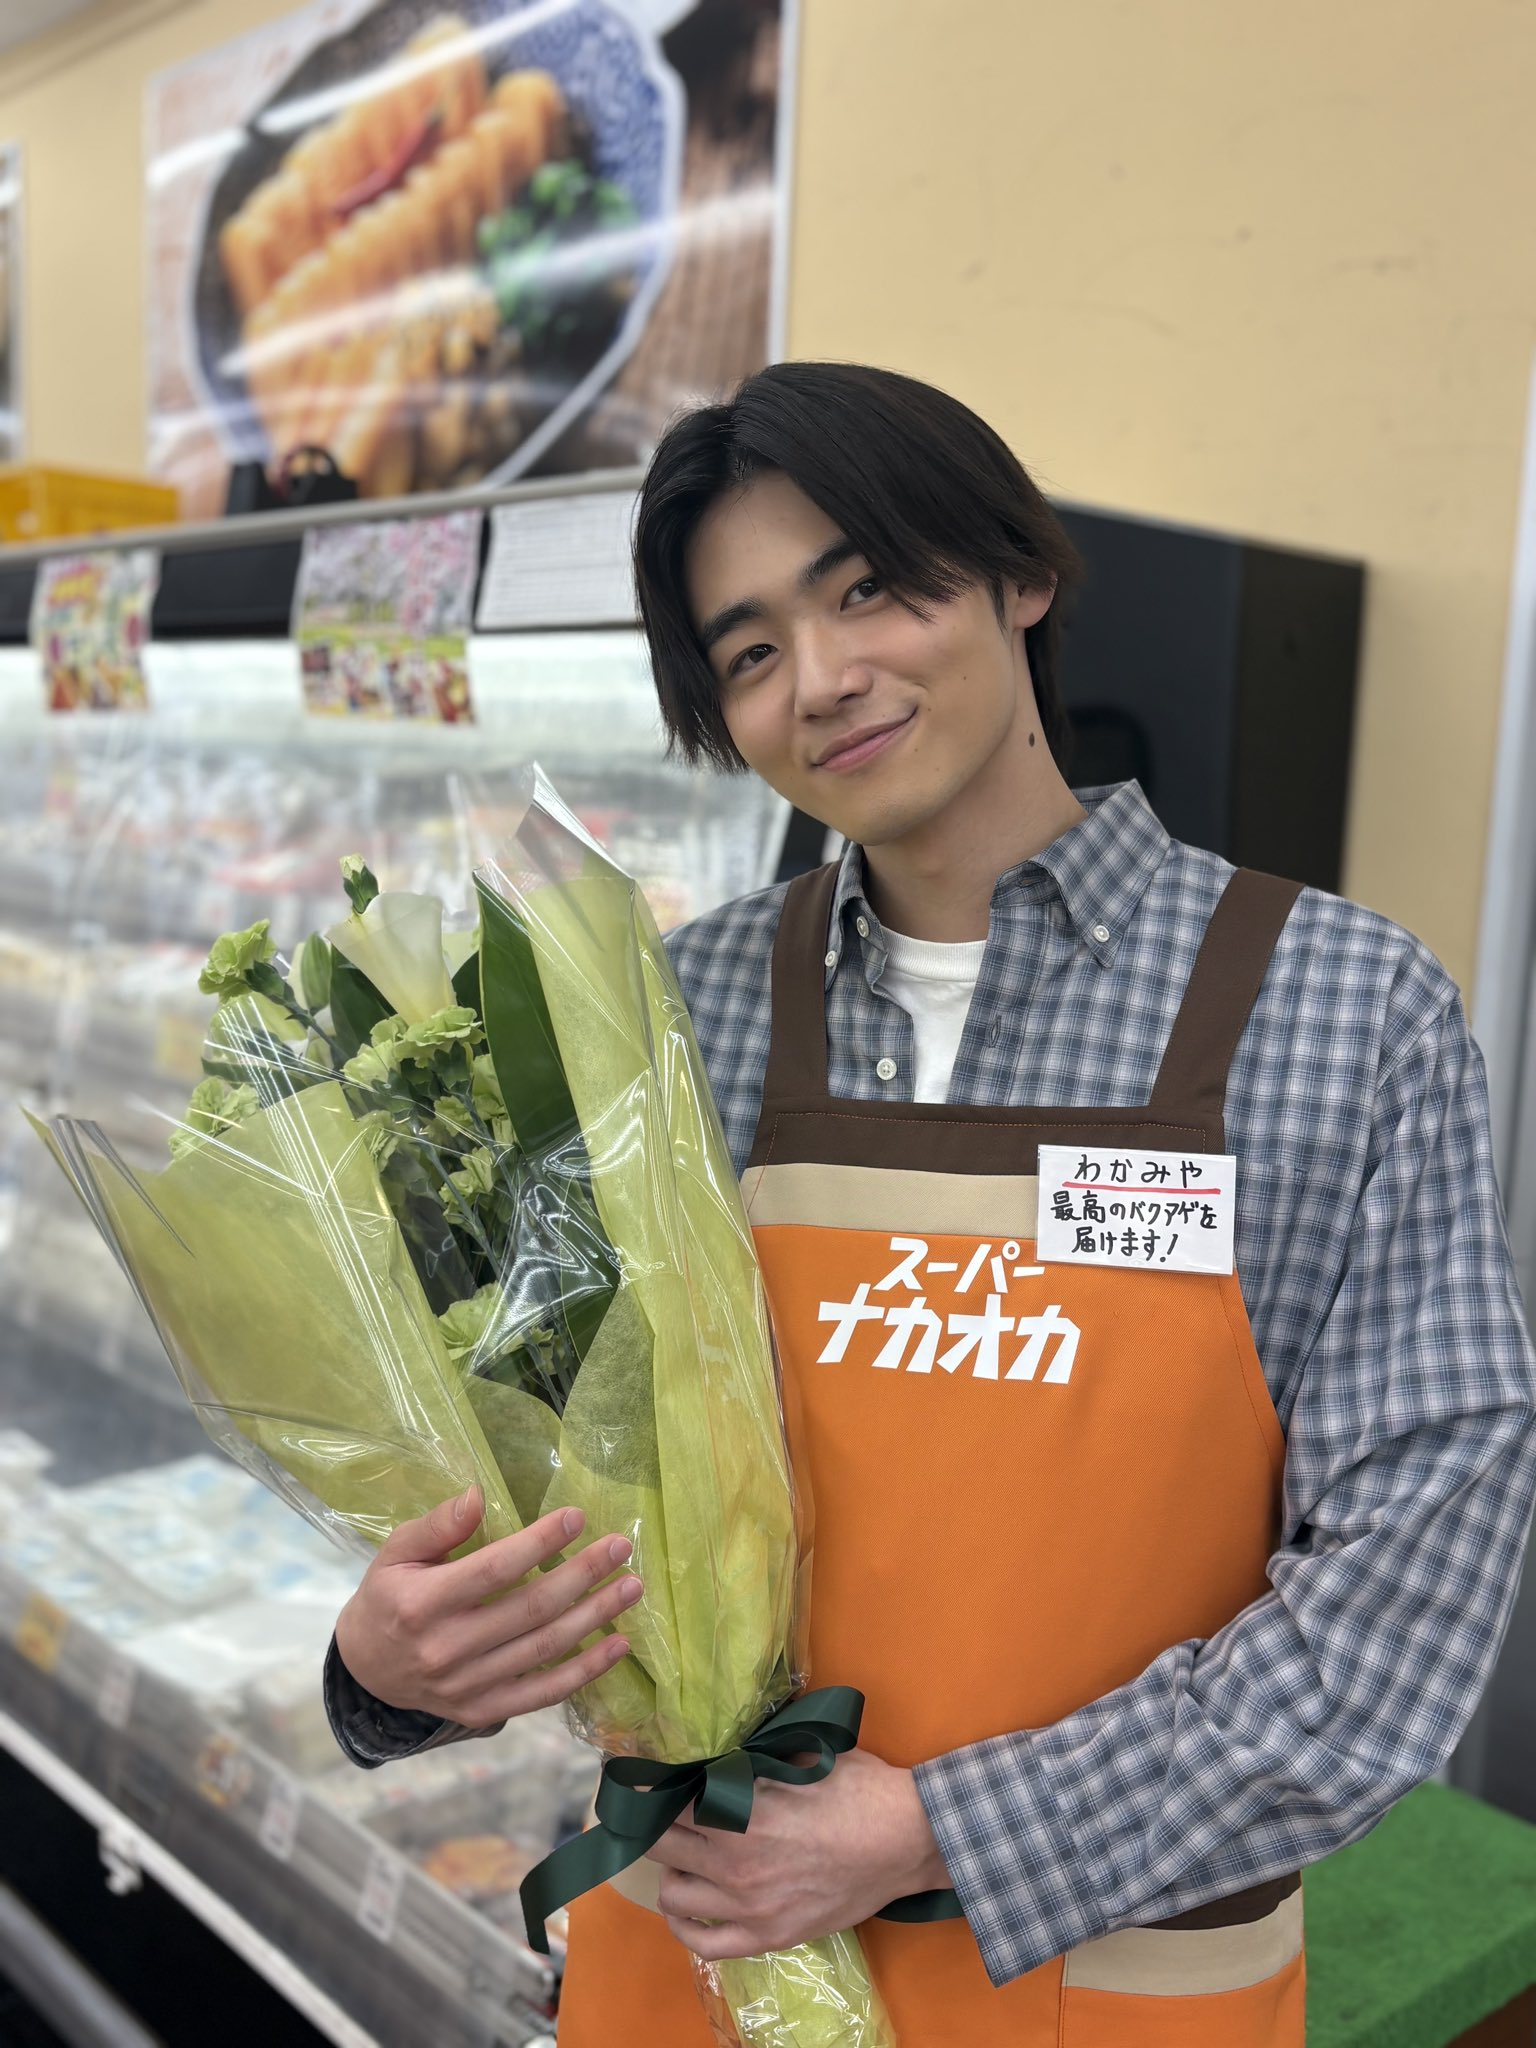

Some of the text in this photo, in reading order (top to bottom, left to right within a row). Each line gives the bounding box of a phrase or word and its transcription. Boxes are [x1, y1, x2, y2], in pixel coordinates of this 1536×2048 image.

[1074, 1154, 1203, 1188] わかみや
[1050, 1190, 1217, 1229] 最高のバクアゲを
[1071, 1226, 1179, 1262] 届けます!
[873, 1236, 1045, 1293] スーパー
[816, 1283, 1082, 1384] ナカオカ
